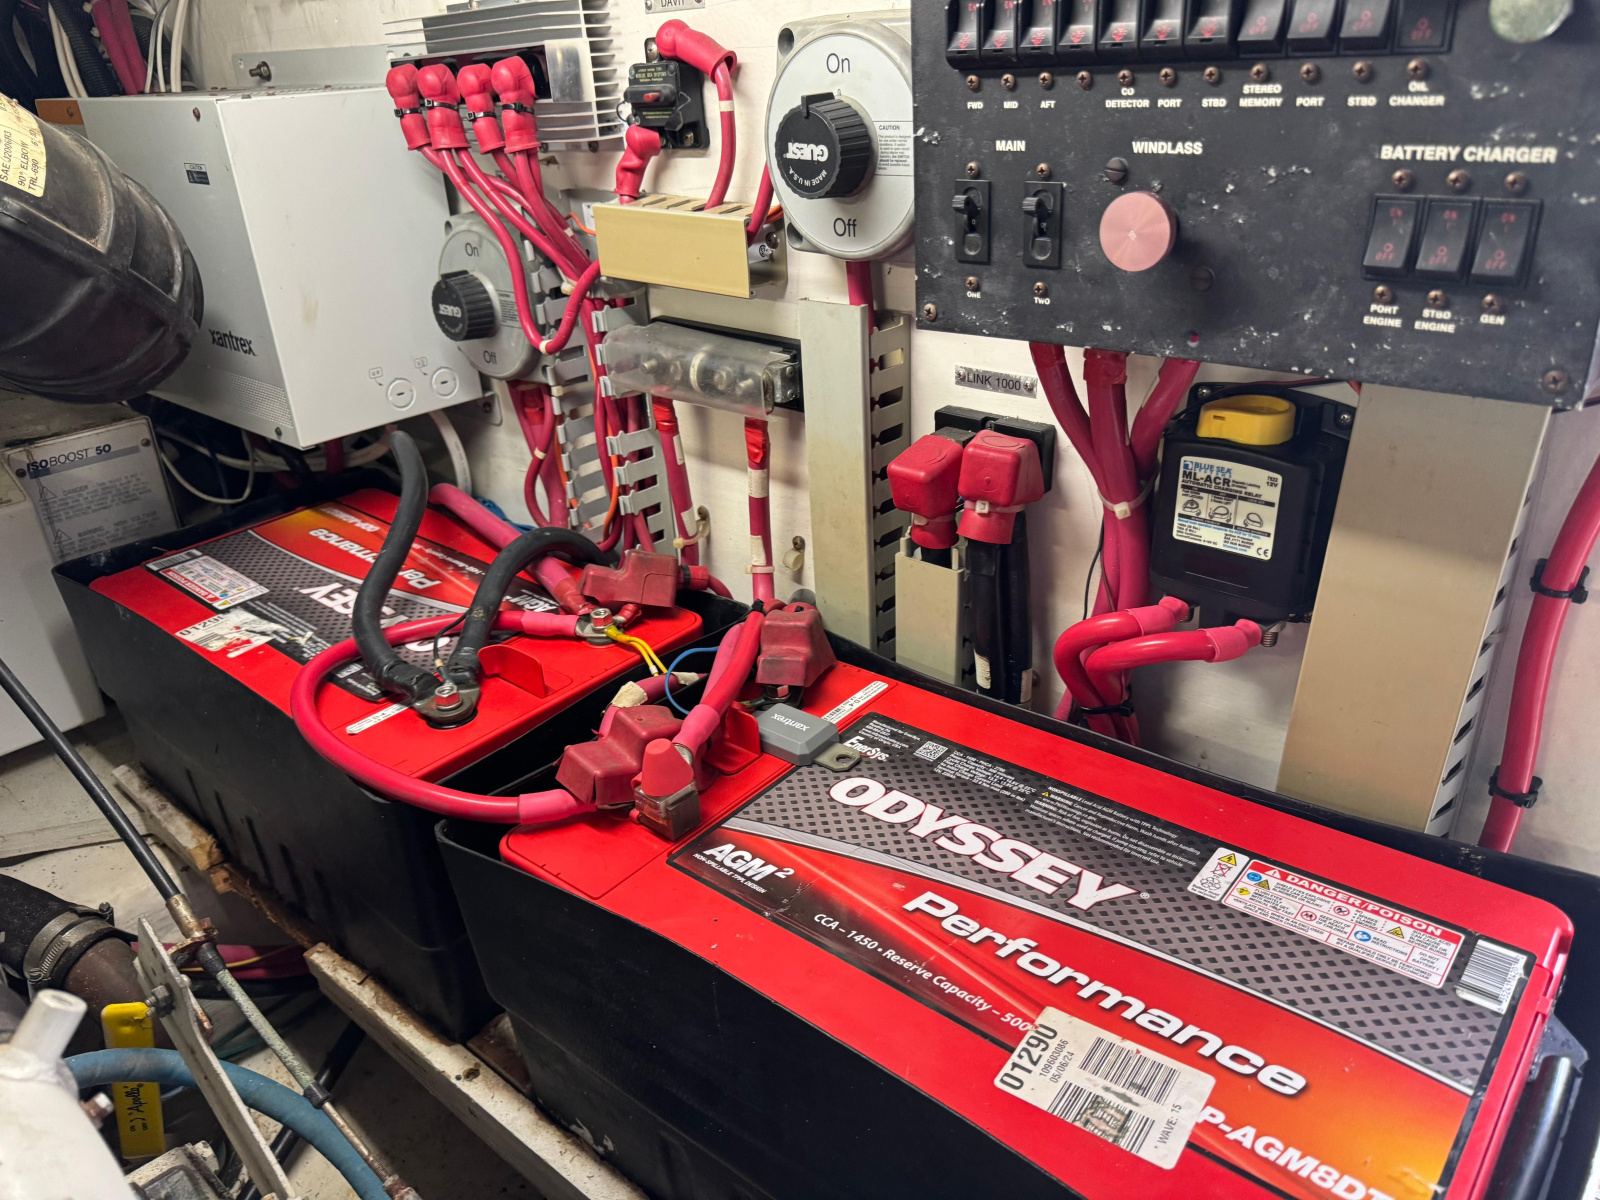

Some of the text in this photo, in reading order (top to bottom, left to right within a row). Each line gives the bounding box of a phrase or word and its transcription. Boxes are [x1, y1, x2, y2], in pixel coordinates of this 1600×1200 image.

[825, 53, 852, 75] On
[1121, 87, 1135, 96] CO
[1242, 84, 1282, 94] STEREO
[1408, 81, 1429, 92] OIL
[1003, 101, 1018, 109] MID
[1040, 100, 1056, 108] AFT
[1105, 99, 1150, 108] DETECTOR
[1157, 98, 1182, 108] PORT
[1202, 98, 1227, 107] STBD
[1239, 98, 1284, 107] MEMORY
[1296, 97, 1325, 106] PORT
[1347, 96, 1377, 106] STBD
[1389, 95, 1445, 107] CHANGER
[786, 142, 829, 162] GUEST
[995, 140, 1026, 152] MAIN
[1131, 141, 1204, 155] WINDLASS
[21, 142, 29, 171] ELBOW
[1380, 144, 1558, 163] BATTERY CHARGER
[0, 163, 11, 181] SAE
[28, 159, 39, 191] TRL-690
[812, 169, 828, 187] MADE
[804, 177, 811, 187] IN
[833, 217, 857, 237] Off
[465, 242, 479, 257] On
[1375, 252, 1395, 261] OFF
[1429, 255, 1449, 265] OFF
[1485, 260, 1507, 270] OFF
[966, 290, 981, 299] ONE
[1033, 297, 1051, 306] TWO
[1370, 304, 1399, 315] PORT
[1422, 309, 1452, 320] STBD
[1363, 316, 1402, 328] ENGINE
[1480, 314, 1506, 325] GEN
[1414, 321, 1456, 333] ENGINE
[208, 329, 257, 357] xantrex
[483, 350, 497, 364] Off
[967, 372, 1021, 391] LINK 1000
[95, 444, 112, 455] 50
[1194, 462, 1232, 474] BLUE SEA
[1182, 470, 1231, 487] ML-ACR
[62, 485, 88, 496] DANGER
[1181, 479, 1212, 489] AUTOMATIC
[1214, 485, 1242, 495] CHARGING
[771, 713, 810, 731] xantrex
[843, 736, 889, 761] EnerSys
[1047, 785, 1082, 800] NONSPILLABLE
[1112, 811, 1130, 819] Battery
[1151, 826, 1178, 838] Technology
[829, 777, 1139, 911] ODYSSEY
[1178, 843, 1201, 854] handling
[693, 853, 733, 876] NON-SPILLABLE
[744, 881, 768, 894] DESIGN
[1192, 883, 1207, 892] Battery
[1286, 875, 1443, 937] DANGER/POISON
[1356, 917, 1376, 926] FLAMES
[1358, 914, 1378, 923] SPARKS
[1323, 923, 1348, 934] CHILDREN
[1328, 921, 1345, 929] REACH
[1372, 936, 1387, 944] READ
[1370, 939, 1408, 956] INSTRUCTIONS
[1411, 958, 1436, 969] BATTERY
[1418, 956, 1435, 965] OPEN
[814, 913, 839, 931] CCA
[847, 930, 879, 949] 1450
[882, 949, 933, 980] Reserve
[933, 975, 993, 1012] Capacity
[1000, 1011, 1030, 1031] 500
[902, 891, 1307, 1095] Performance
[1039, 1039, 1069, 1078] 109603086
[1049, 1051, 1076, 1084] 05/06/24
[1157, 1103, 1183, 1145] WAVE: 15
